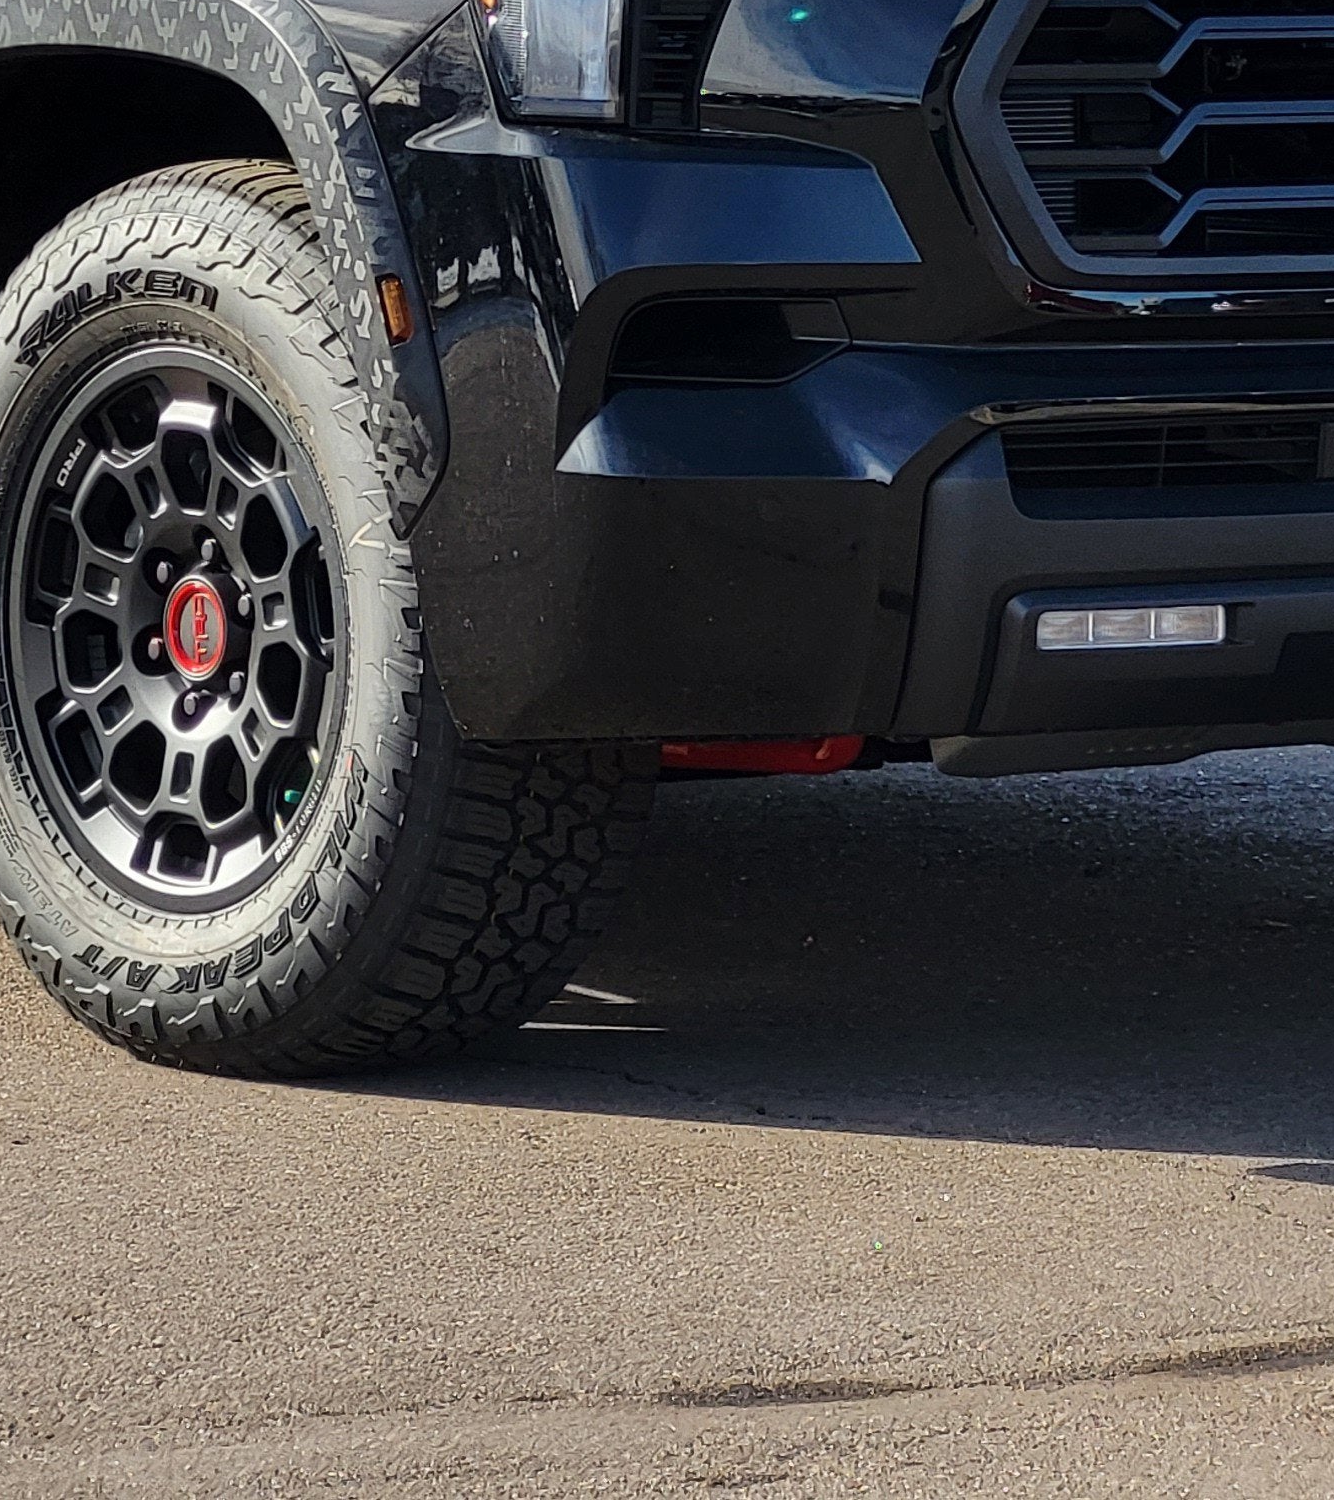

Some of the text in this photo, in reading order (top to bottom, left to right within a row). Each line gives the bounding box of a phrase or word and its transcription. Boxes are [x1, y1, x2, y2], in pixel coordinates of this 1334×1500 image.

[15, 267, 218, 367] FALKEN
[56, 438, 86, 488] PRO
[160, 749, 368, 993] WILDPEAK
[72, 943, 162, 992] A/T
